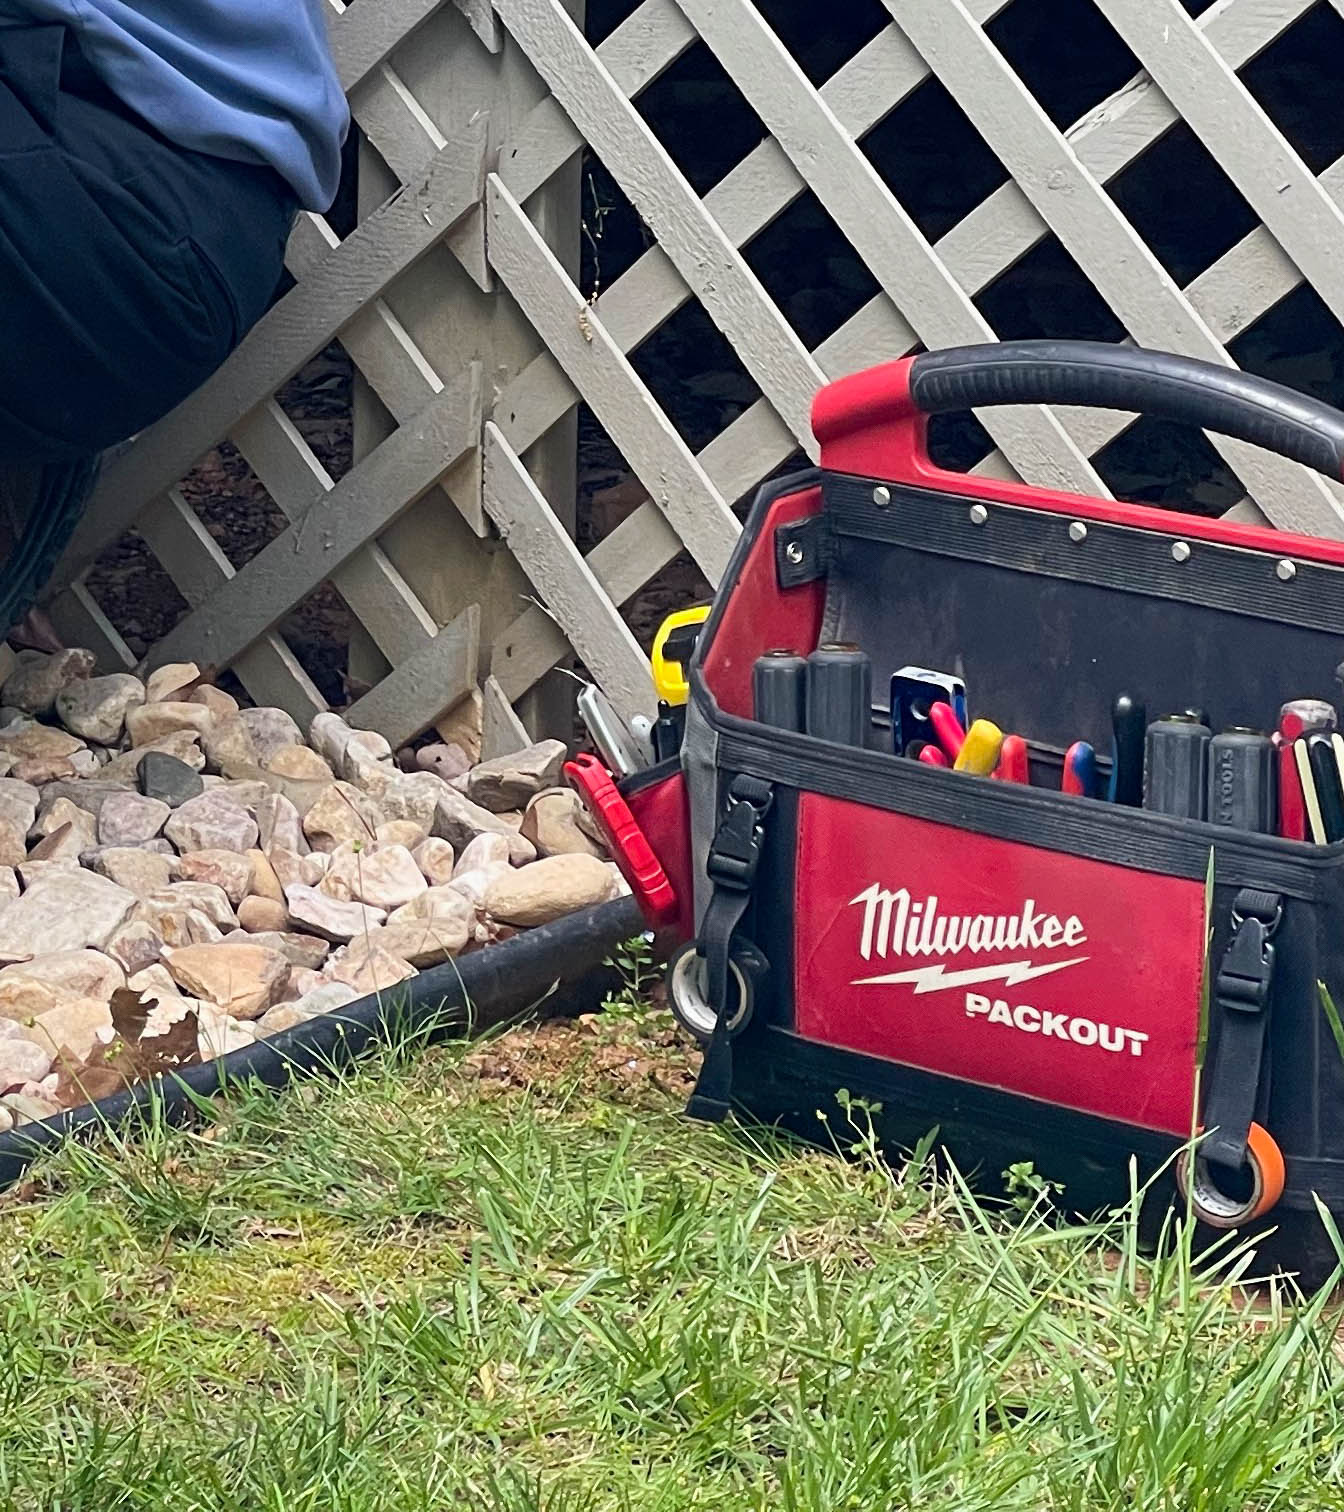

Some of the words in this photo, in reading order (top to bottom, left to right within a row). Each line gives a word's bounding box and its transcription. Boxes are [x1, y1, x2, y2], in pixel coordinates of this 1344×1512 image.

[1221, 748, 1235, 807] TOOLS
[848, 882, 1088, 961] Milwaukee
[965, 992, 1149, 1057] PACKOUT
